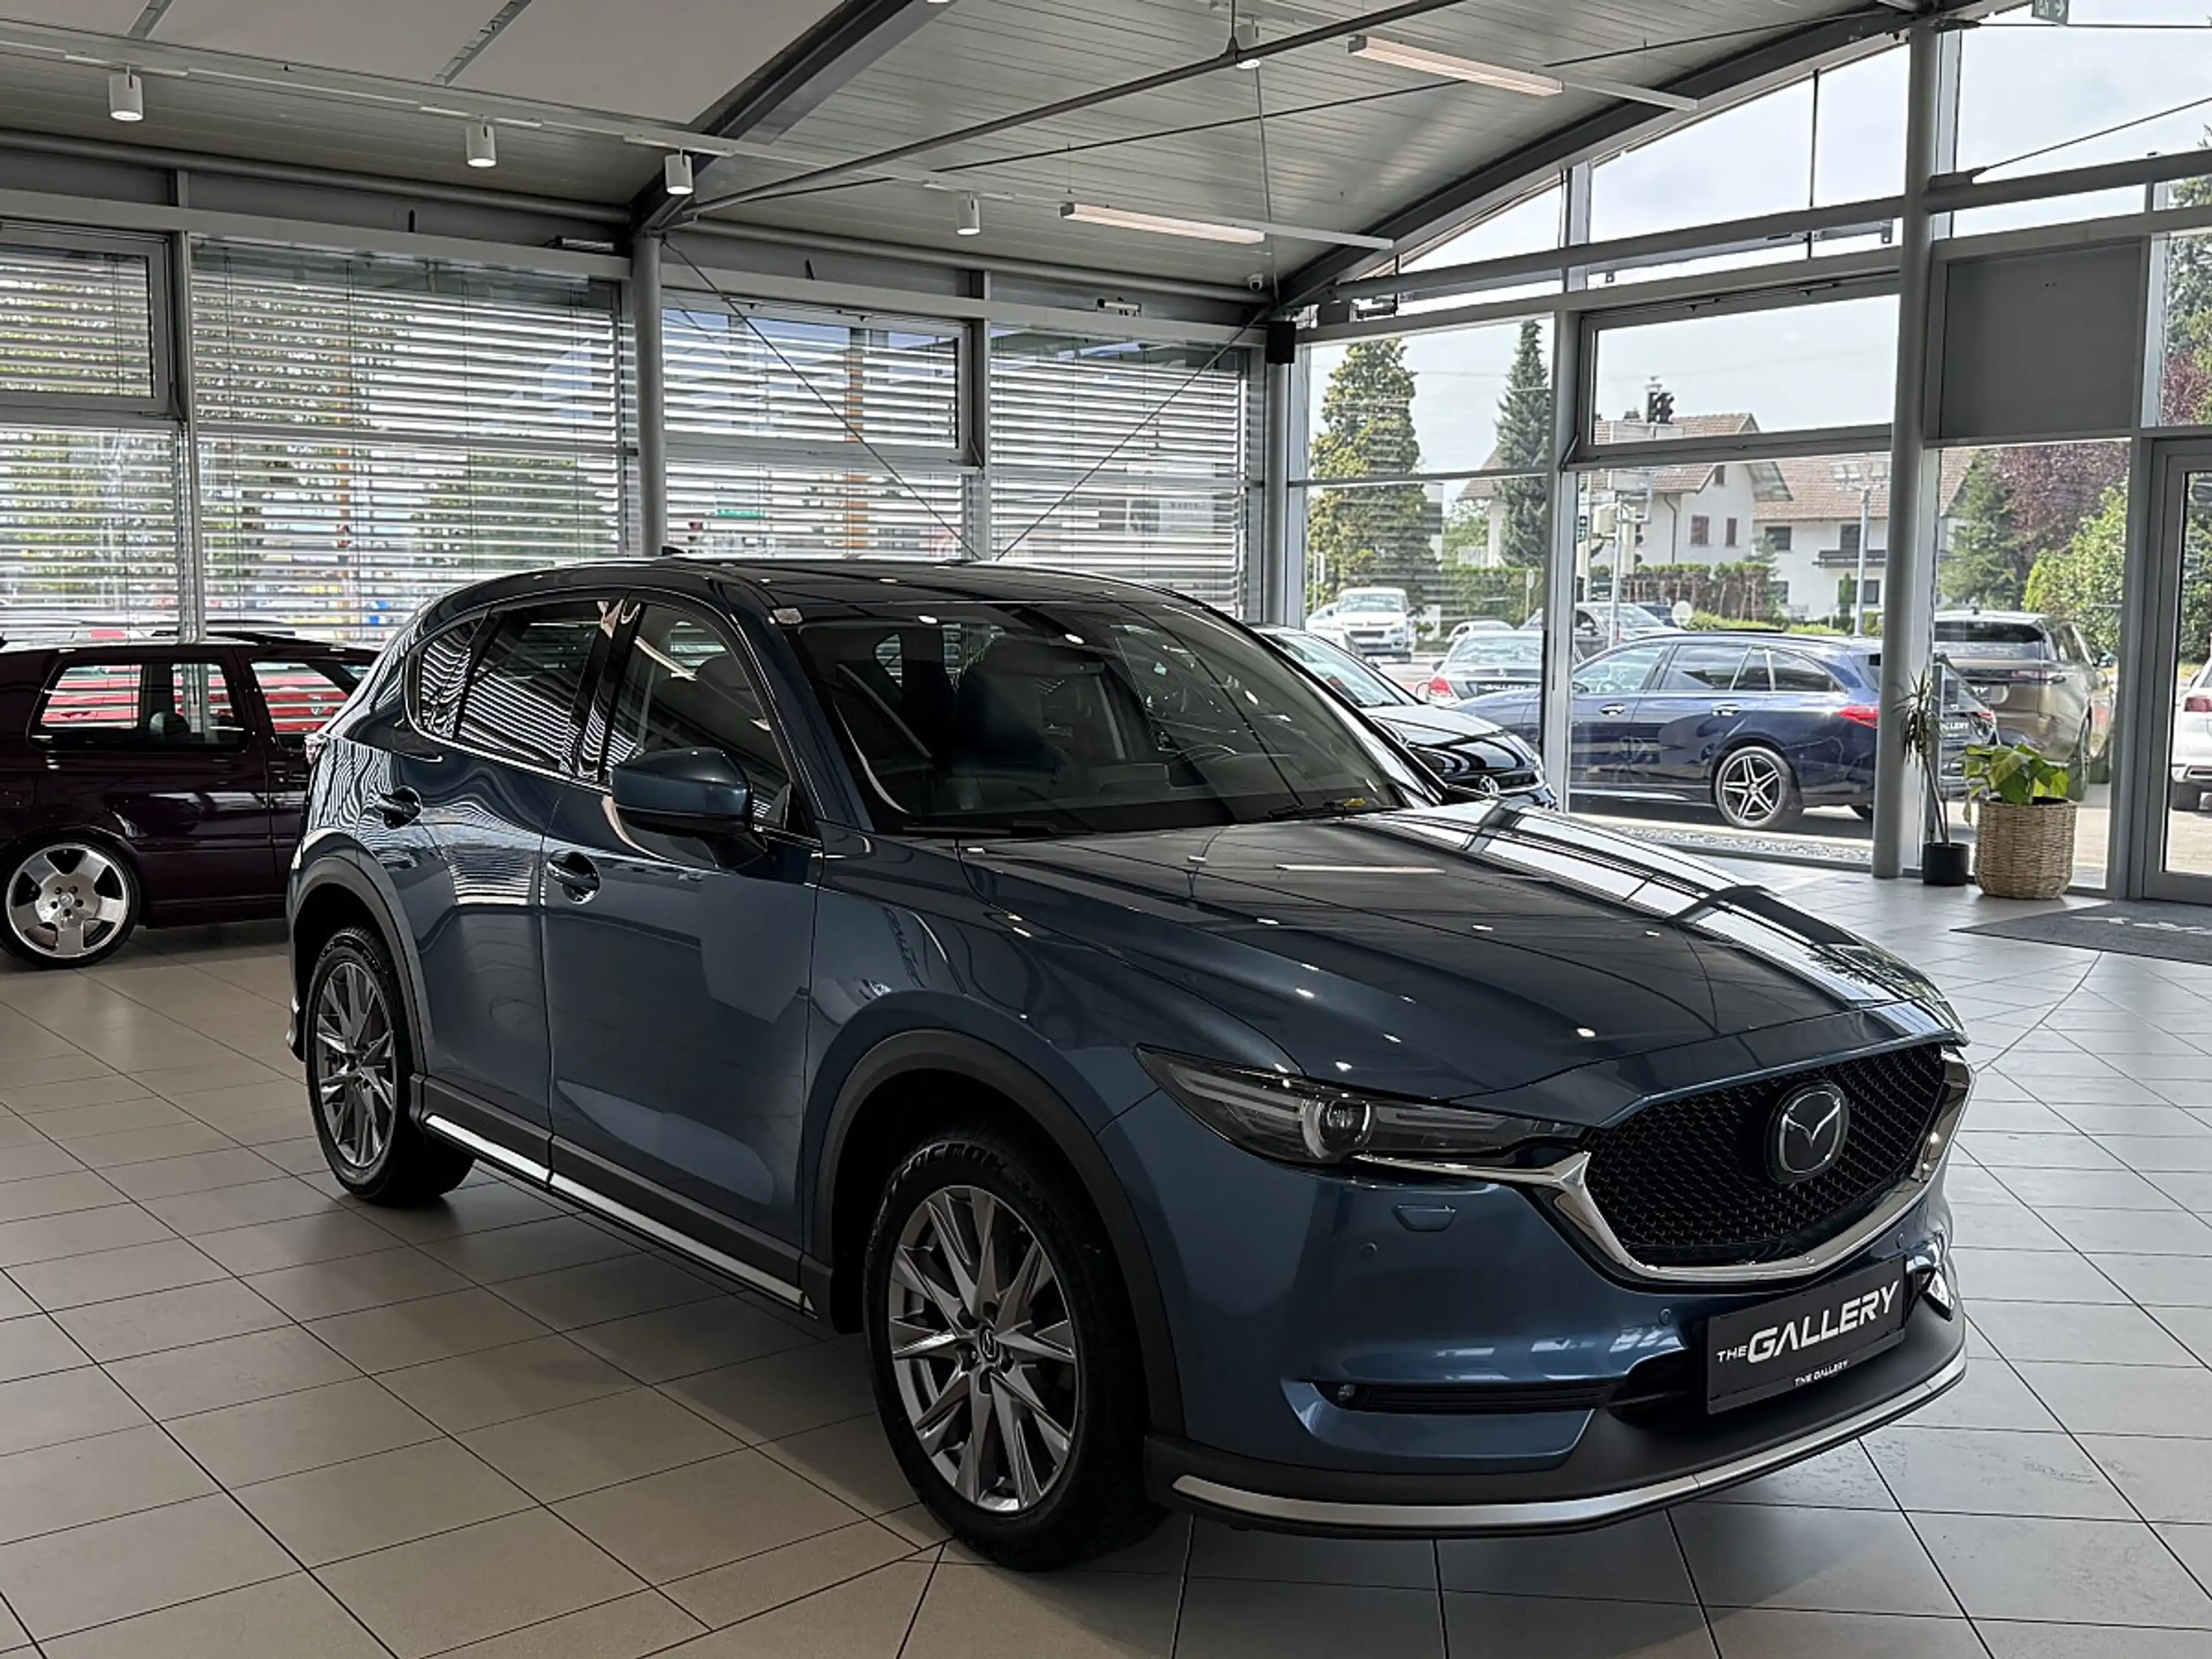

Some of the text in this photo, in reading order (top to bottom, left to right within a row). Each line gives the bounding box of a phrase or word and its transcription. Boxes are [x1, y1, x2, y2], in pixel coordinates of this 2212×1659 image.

[1716, 1279, 1900, 1363] THE GALLERY
[1814, 1359, 1849, 1380] GALLERY
